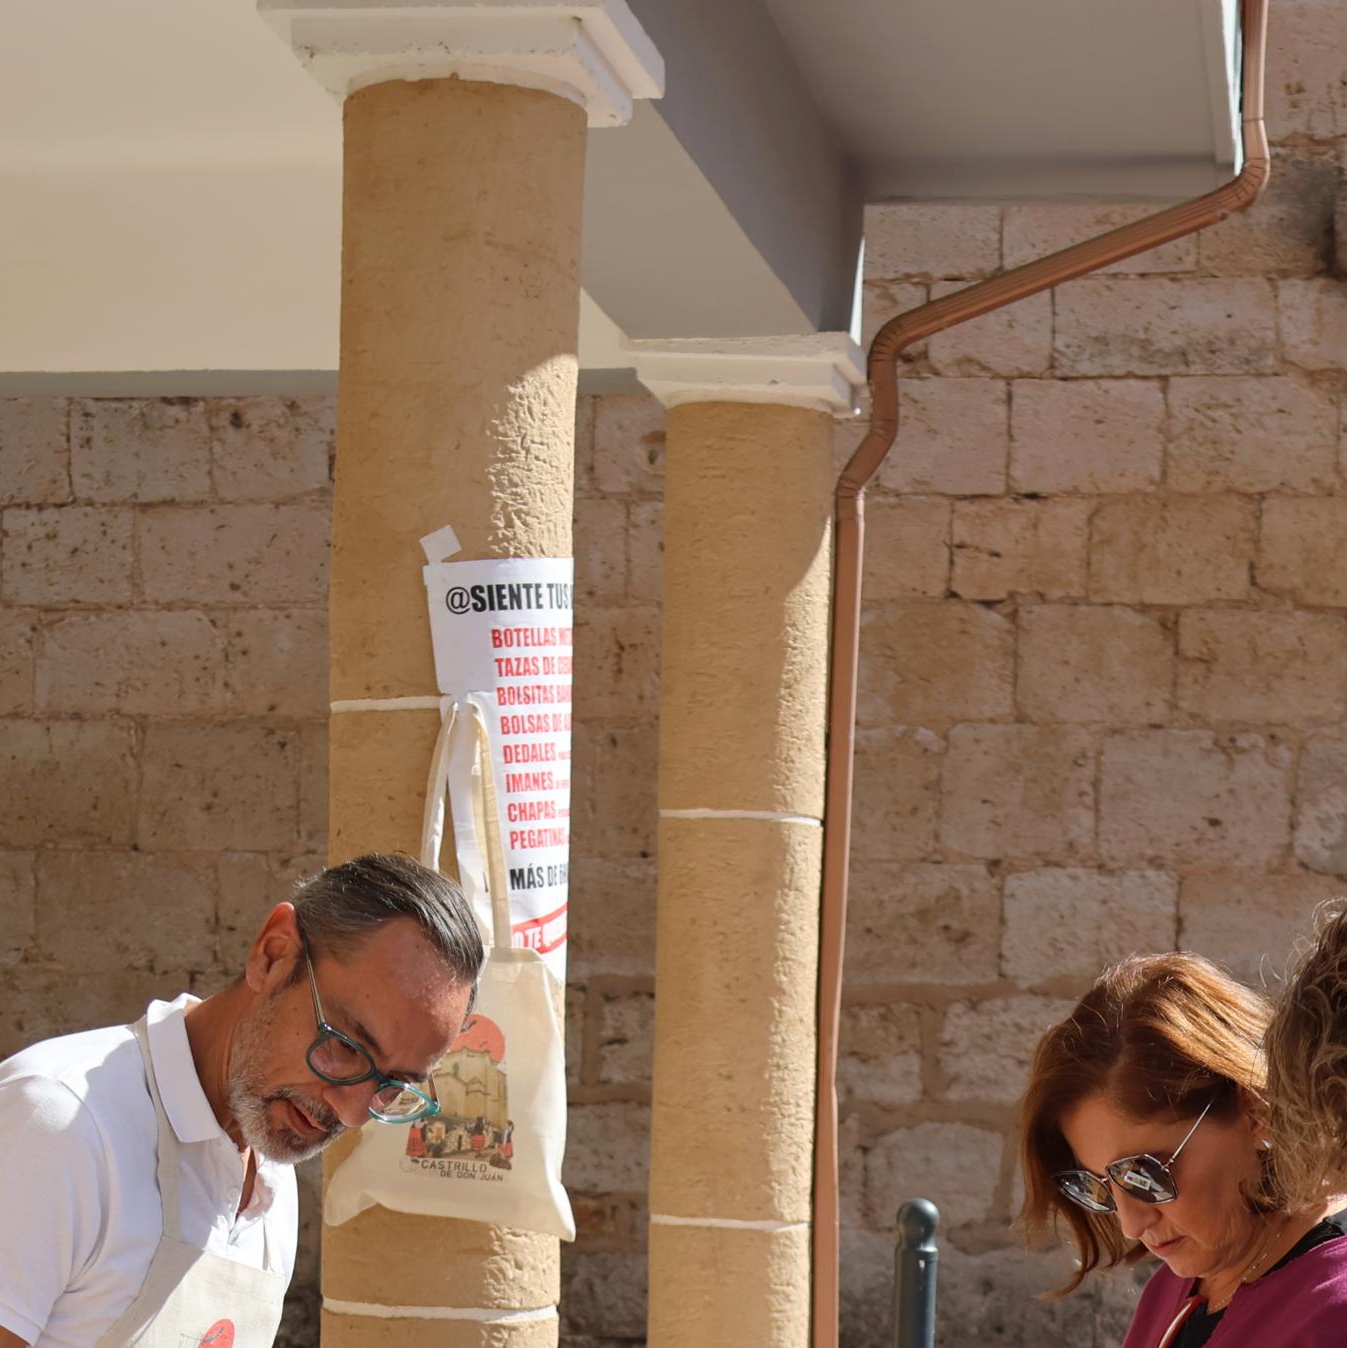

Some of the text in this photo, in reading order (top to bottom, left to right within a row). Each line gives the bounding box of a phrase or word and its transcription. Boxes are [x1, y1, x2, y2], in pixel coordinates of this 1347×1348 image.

[446, 583, 569, 615] @SIENTE TUS
[492, 627, 557, 648] BOTELLAS
[494, 656, 540, 677] TAZAS
[543, 655, 555, 675] DE
[497, 685, 554, 706] BOLSITAS
[500, 714, 550, 735] BOLSAS
[503, 742, 556, 764] DEDALES
[505, 772, 553, 793] IMANES
[507, 801, 556, 822] CHAPAS
[510, 864, 545, 890] MÁS
[421, 1160, 487, 1174] CASTRILLO
[440, 1170, 452, 1178] DE
[456, 1171, 476, 1180] DON
